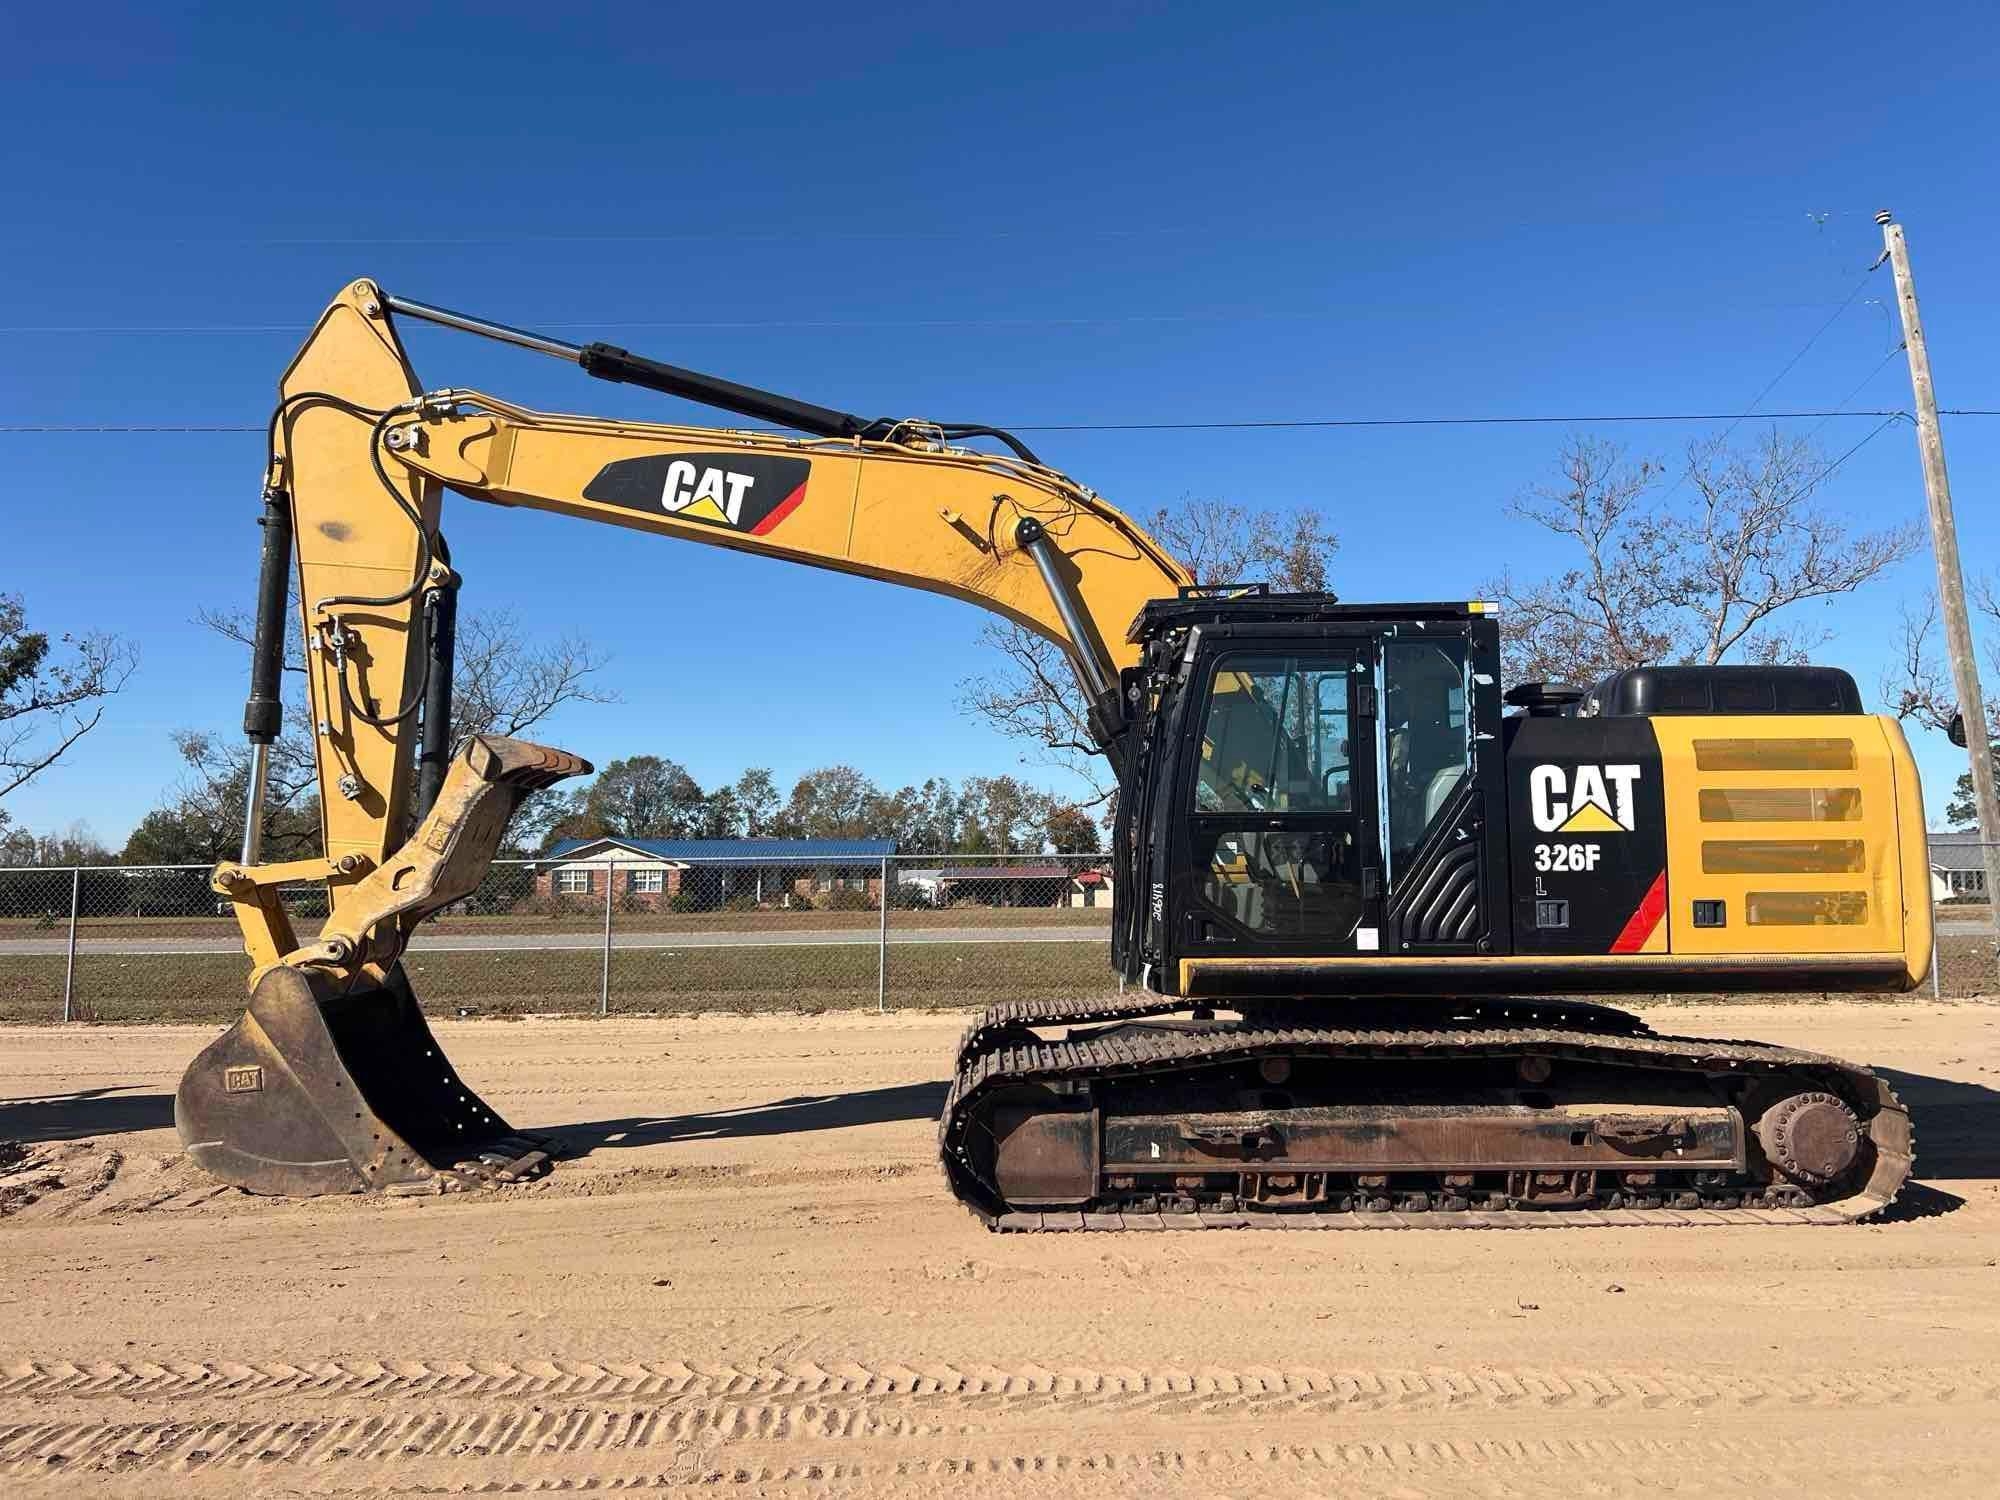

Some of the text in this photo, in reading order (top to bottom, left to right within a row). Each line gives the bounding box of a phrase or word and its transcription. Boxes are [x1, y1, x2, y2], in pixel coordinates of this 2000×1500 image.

[662, 460, 755, 525] CAT
[1530, 764, 1641, 832] CAT
[1534, 843, 1601, 871] 326F
[1535, 876, 1547, 896] L
